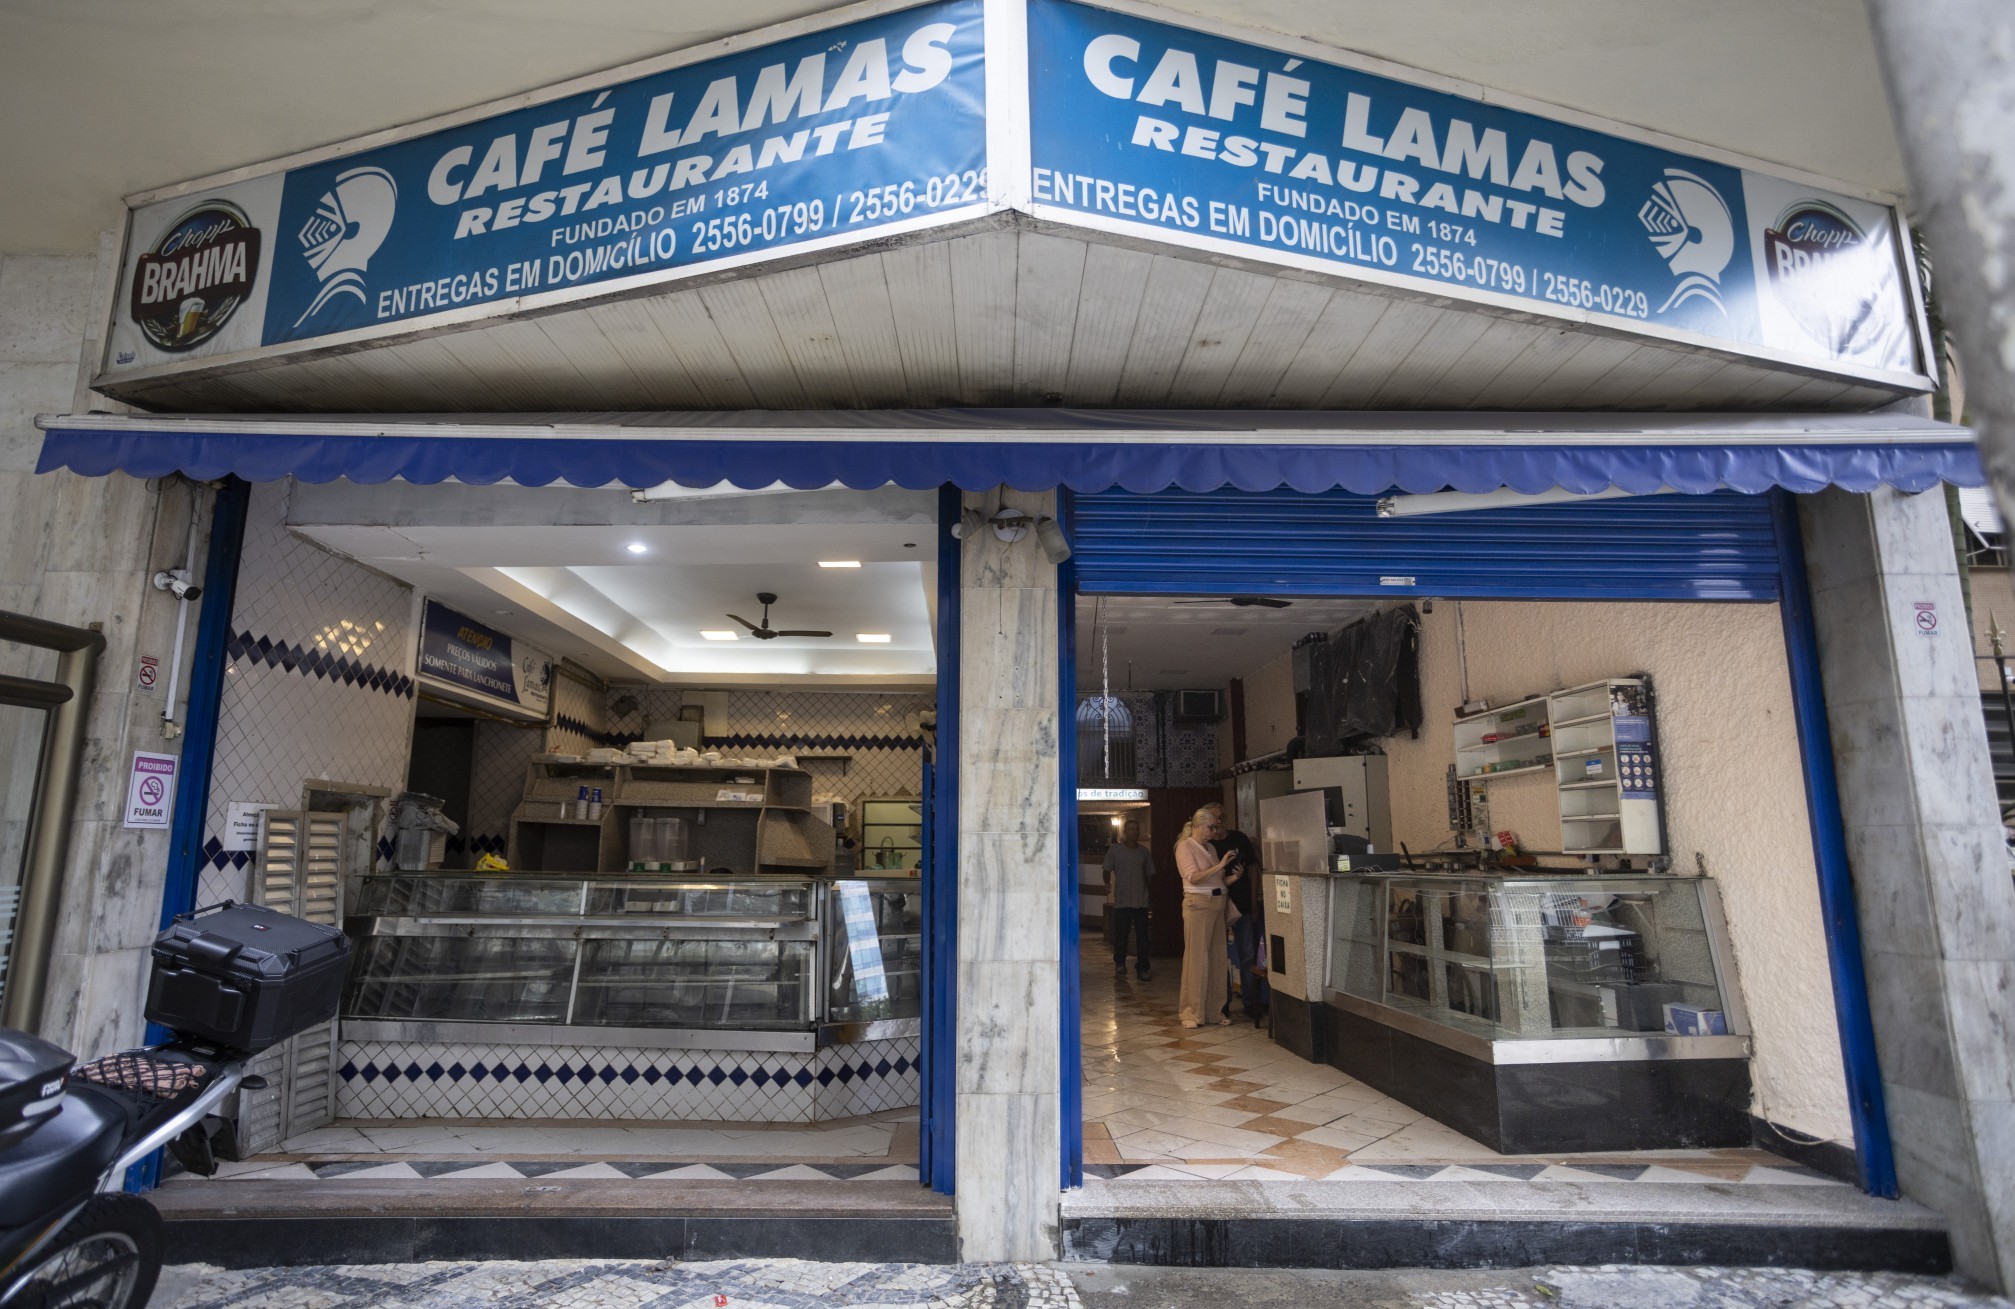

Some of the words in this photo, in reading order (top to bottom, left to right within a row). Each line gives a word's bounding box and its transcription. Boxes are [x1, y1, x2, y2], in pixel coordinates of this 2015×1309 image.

[427, 90, 616, 206] CAFÉ
[637, 22, 957, 158] LAMAS
[1083, 34, 1311, 138] CAFÉ
[1341, 91, 1606, 208] LAMAS
[453, 111, 891, 240] RESTAURANTE
[1130, 115, 1566, 239] RESTAURANTE
[551, 206, 665, 248] FUNDADO
[671, 194, 705, 219] EM
[713, 181, 769, 208] 1874
[1257, 182, 1379, 226] FUNDADO
[1386, 210, 1420, 235] EM
[1427, 220, 1477, 247] 1874
[161, 219, 235, 257] Chopp
[377, 267, 499, 319] ENTREGAS
[505, 258, 541, 293] EM
[547, 227, 677, 286] DOMICÍLIO
[691, 199, 824, 254] 2556-0799
[849, 170, 988, 224] 2556-0229
[1033, 167, 1200, 228] ENTREGAS
[1208, 200, 1250, 238] EM
[1259, 211, 1397, 266] DOMICÍLIO
[1411, 243, 1525, 294] 2556-0799
[1543, 272, 1648, 319] 2556-0229
[1787, 221, 1858, 248] Chopp
[140, 241, 246, 304] BRAHMA
[447, 643, 471, 661] PREÇOS
[471, 652, 497, 672] VÁLIDOS
[457, 627, 493, 650] ATENÇÃO
[425, 653, 457, 675] SOMENTE
[457, 666, 473, 681] PARA
[473, 672, 511, 694] LANCHONETE
[138, 761, 173, 772] PROIBIDO
[133, 807, 163, 817] FUMAR
[1104, 789, 1144, 799] tradição
[1276, 879, 1289, 887] FICHA
[1280, 890, 1286, 898] NO
[1278, 900, 1290, 909] CAIXA
